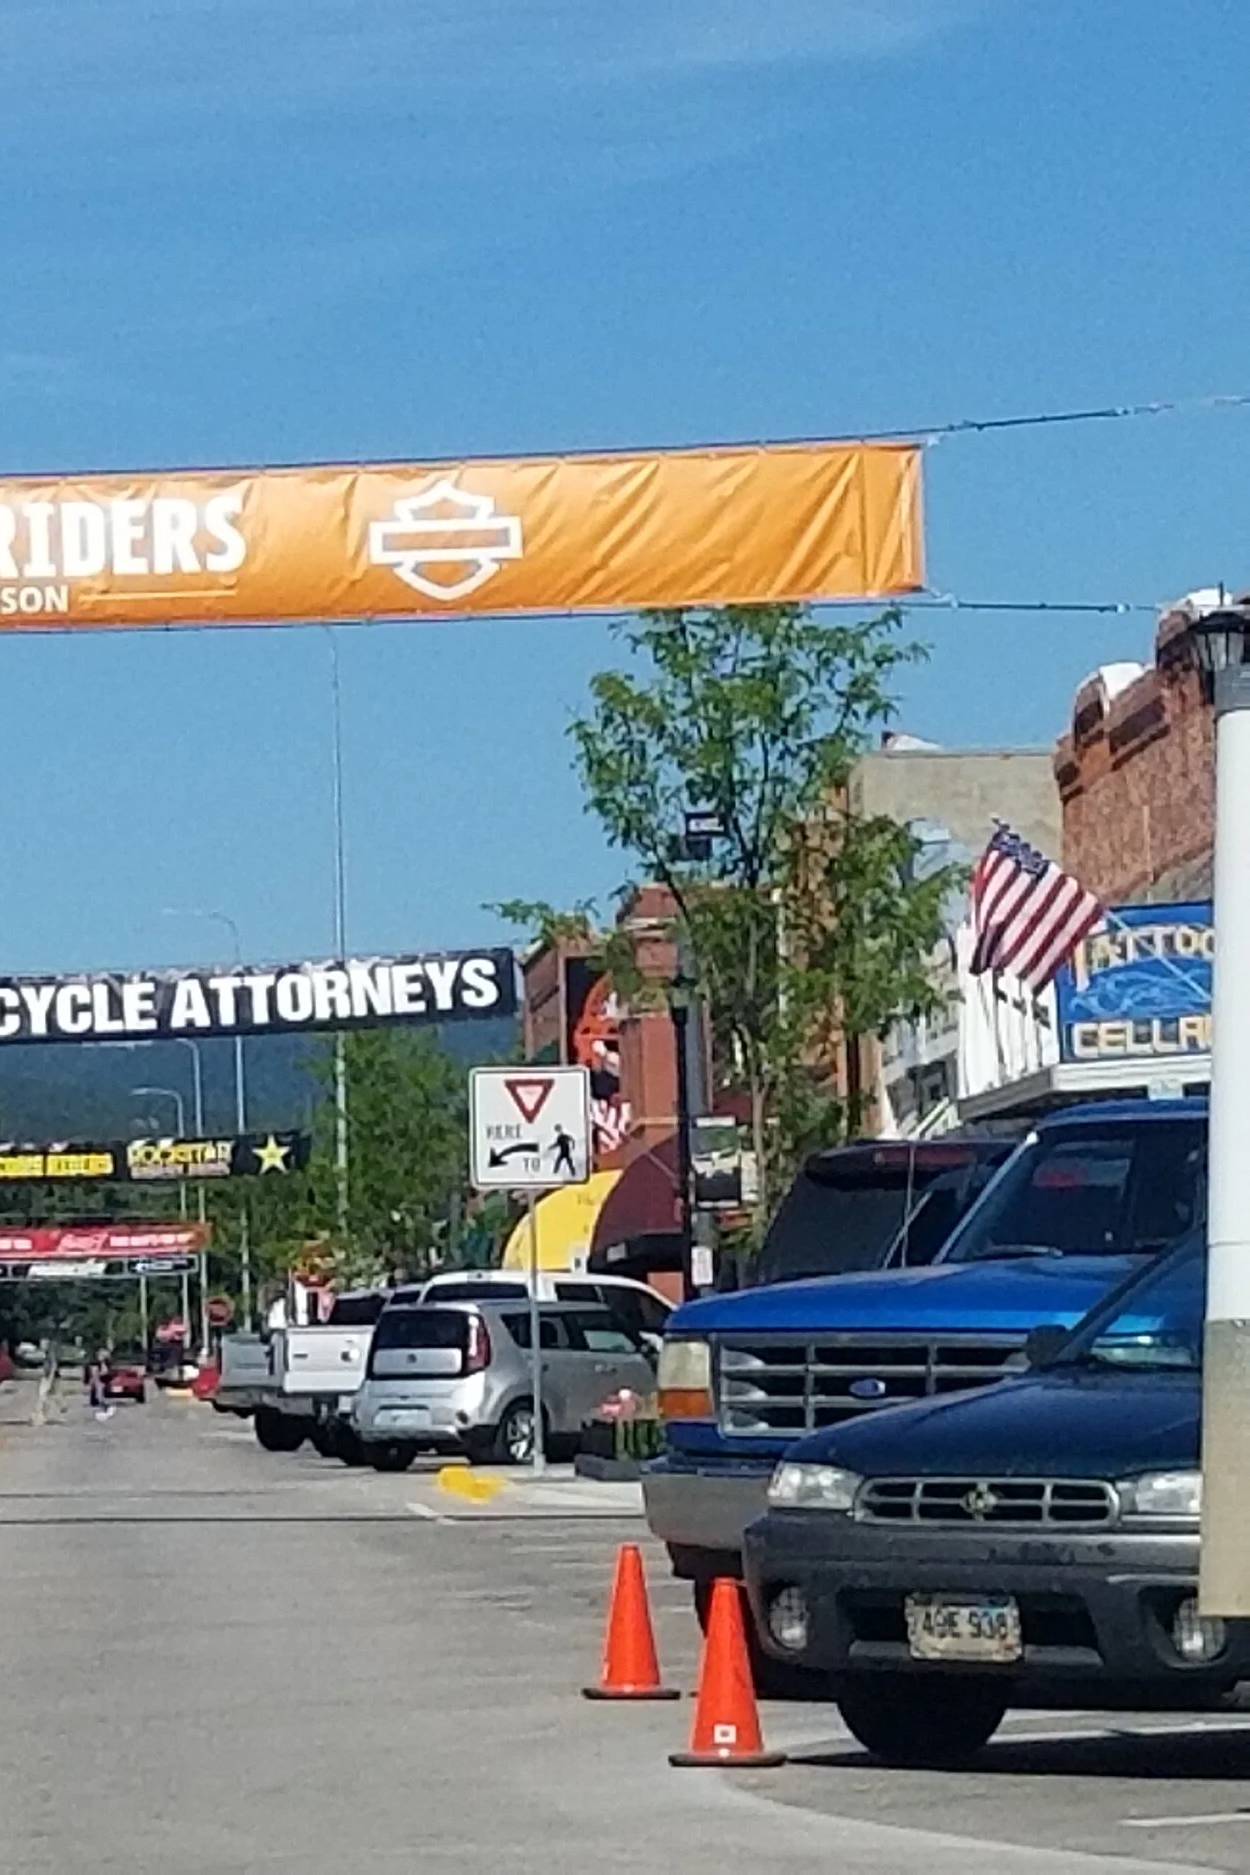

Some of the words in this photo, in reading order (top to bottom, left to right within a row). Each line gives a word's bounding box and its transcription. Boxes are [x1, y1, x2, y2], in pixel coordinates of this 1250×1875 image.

[170, 958, 498, 1029] ATTORNEYS
[486, 1123, 521, 1140] HERE
[522, 1157, 541, 1173] TO
